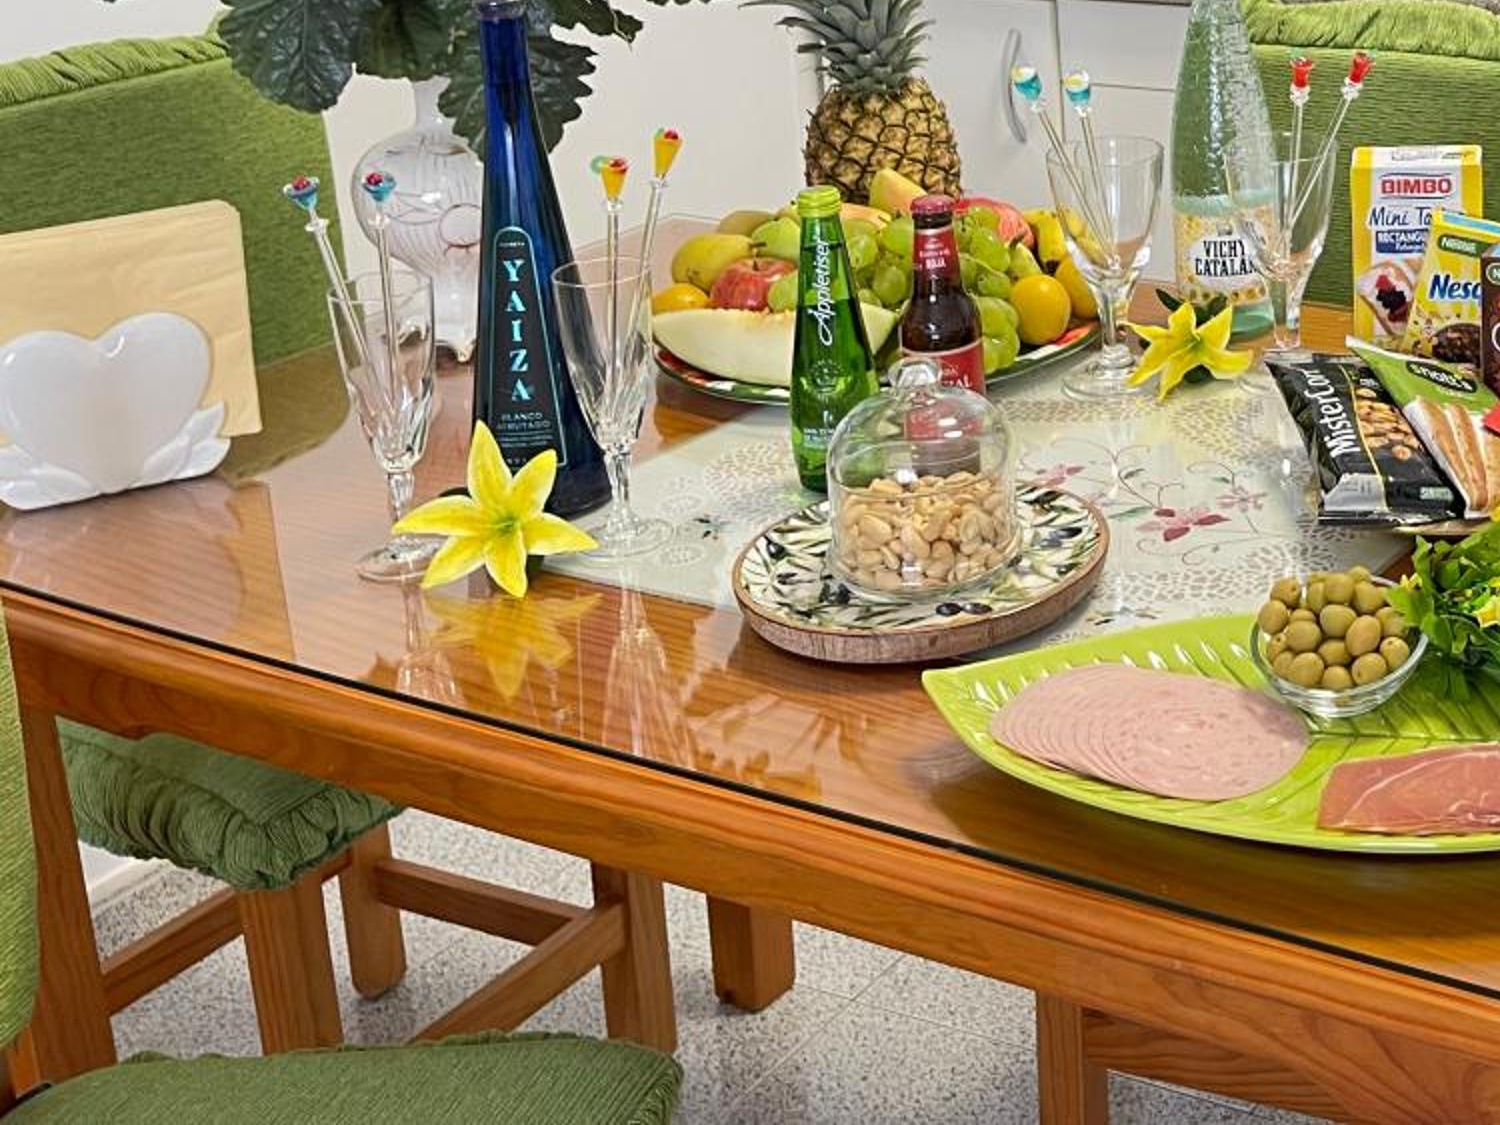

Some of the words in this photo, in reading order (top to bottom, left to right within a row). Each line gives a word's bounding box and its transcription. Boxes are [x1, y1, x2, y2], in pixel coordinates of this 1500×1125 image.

[1381, 178, 1452, 194] BIMBO
[1369, 206, 1409, 226] Mini
[1203, 239, 1245, 258] VICHY
[808, 236, 836, 346] Appletiser
[502, 258, 533, 401] YAIZA
